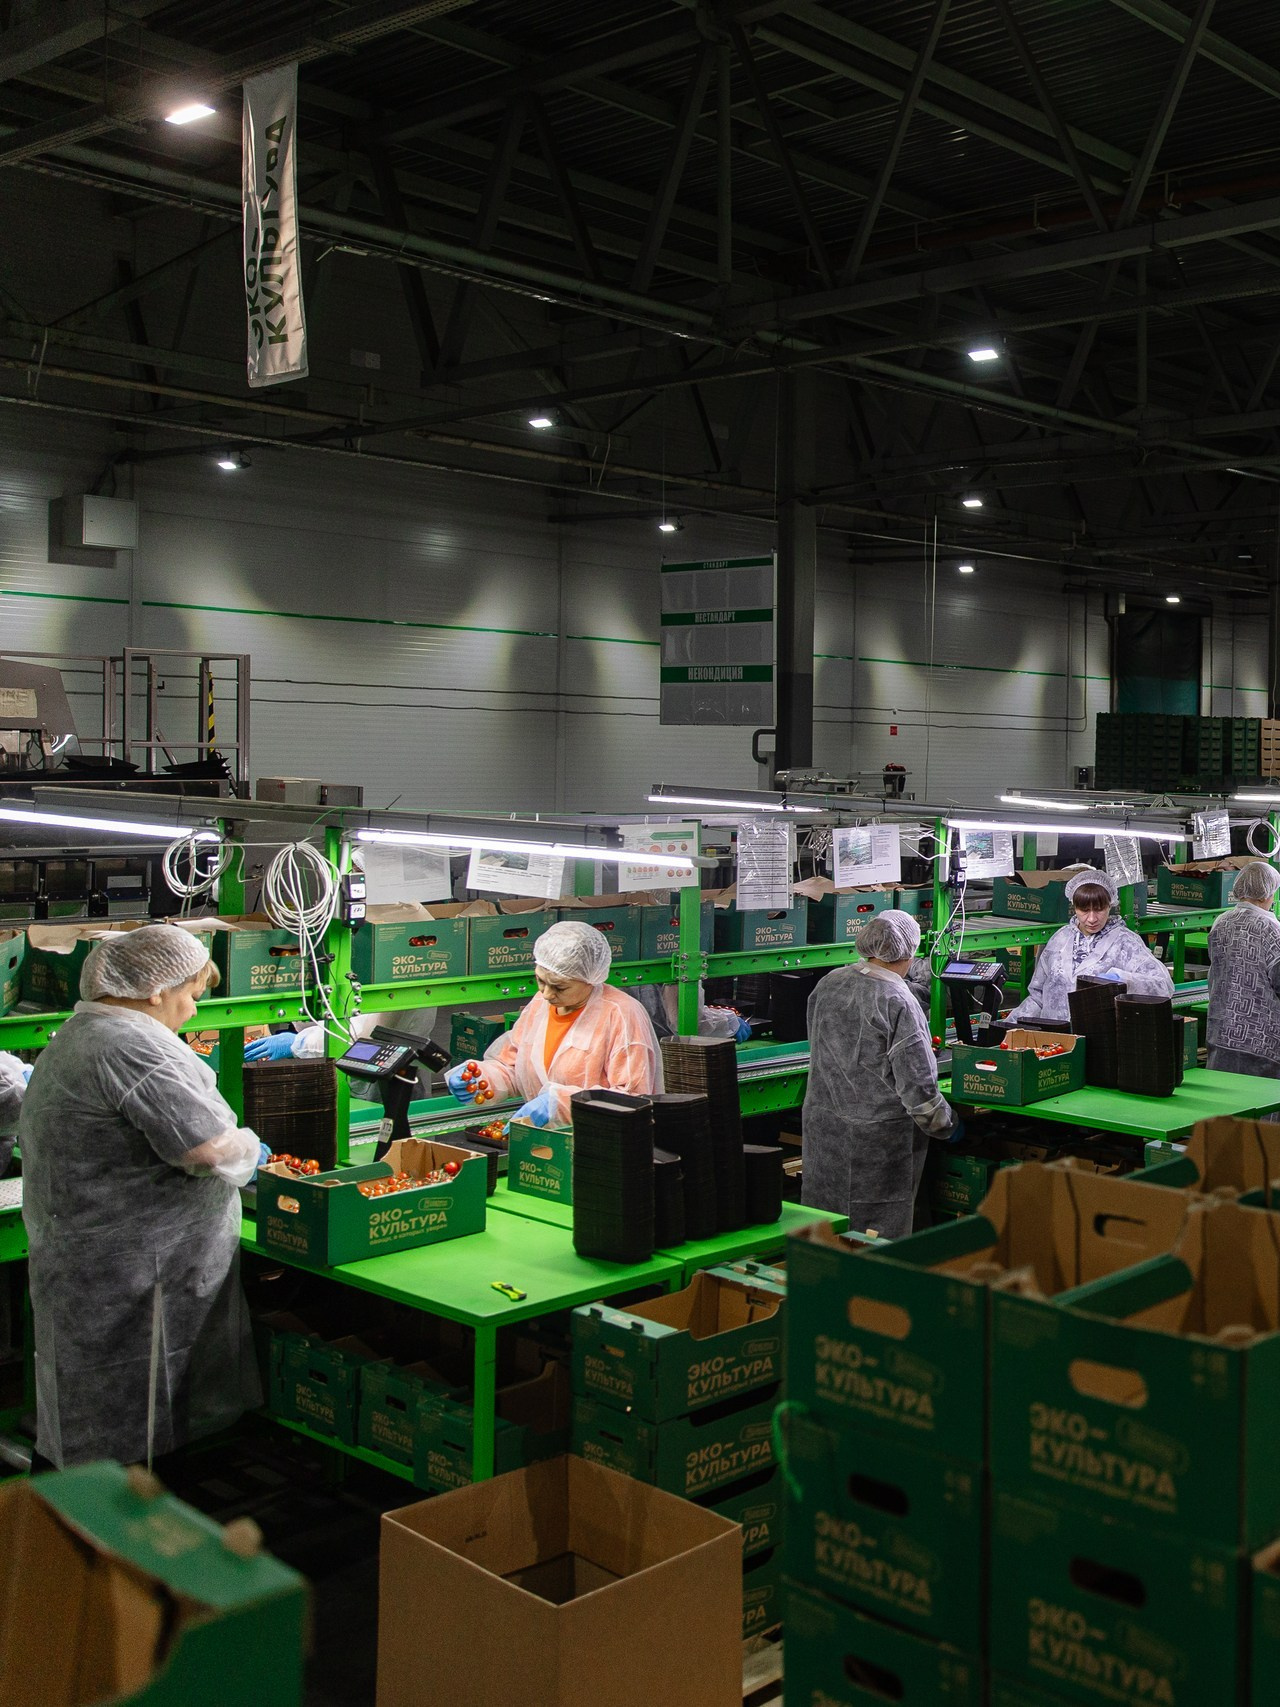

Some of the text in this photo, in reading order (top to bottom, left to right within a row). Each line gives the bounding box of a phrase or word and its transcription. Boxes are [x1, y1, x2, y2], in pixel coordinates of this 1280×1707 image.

[694, 611, 736, 624] НЕСТАНДАРТ
[687, 666, 744, 682] НЕКОНДИЦИЯ
[1007, 893, 1025, 901] ЭКО-
[1171, 889, 1203, 898] КУЛЬТУРА
[1007, 900, 1041, 912] КУЛЬТУРА
[755, 927, 777, 935] ЭКО-
[755, 933, 793, 943] КУЛЬТУРА
[488, 946, 517, 955] ЭКО-
[488, 953, 534, 965] КУЛЬТУР
[392, 955, 424, 965] ЭКО-
[392, 961, 448, 975] КУЛЬТУРА
[250, 964, 286, 975] ЭКО-
[963, 1073, 986, 1082] ЭКО-
[963, 1081, 1005, 1094] КУЛЬТУРА
[519, 1160, 542, 1173] ЭКО-
[519, 1171, 560, 1190] КУЛЬТУРА
[369, 1208, 413, 1225] ЭКО-
[369, 1211, 447, 1239] КУЛЬТУРА
[813, 1334, 880, 1371] ЭКО-
[687, 1356, 736, 1381] ЭКО-
[687, 1356, 774, 1398] КУЛЬТУРА
[584, 1369, 633, 1395] КУЛЬТУРА
[814, 1361, 935, 1420] КУЛЬТУРА
[1028, 1402, 1110, 1442] ЭКО-
[685, 1442, 735, 1469] ЭКО-
[685, 1440, 771, 1487] КУЛЬТУРА
[1028, 1431, 1178, 1498] КУЛЬТУРА
[814, 1510, 879, 1549] ЭКО-
[814, 1537, 933, 1605] КУЛЬТУРА
[1027, 1597, 1107, 1644] ЭКО-
[1027, 1626, 1174, 1703] КУЛЬТУРА
